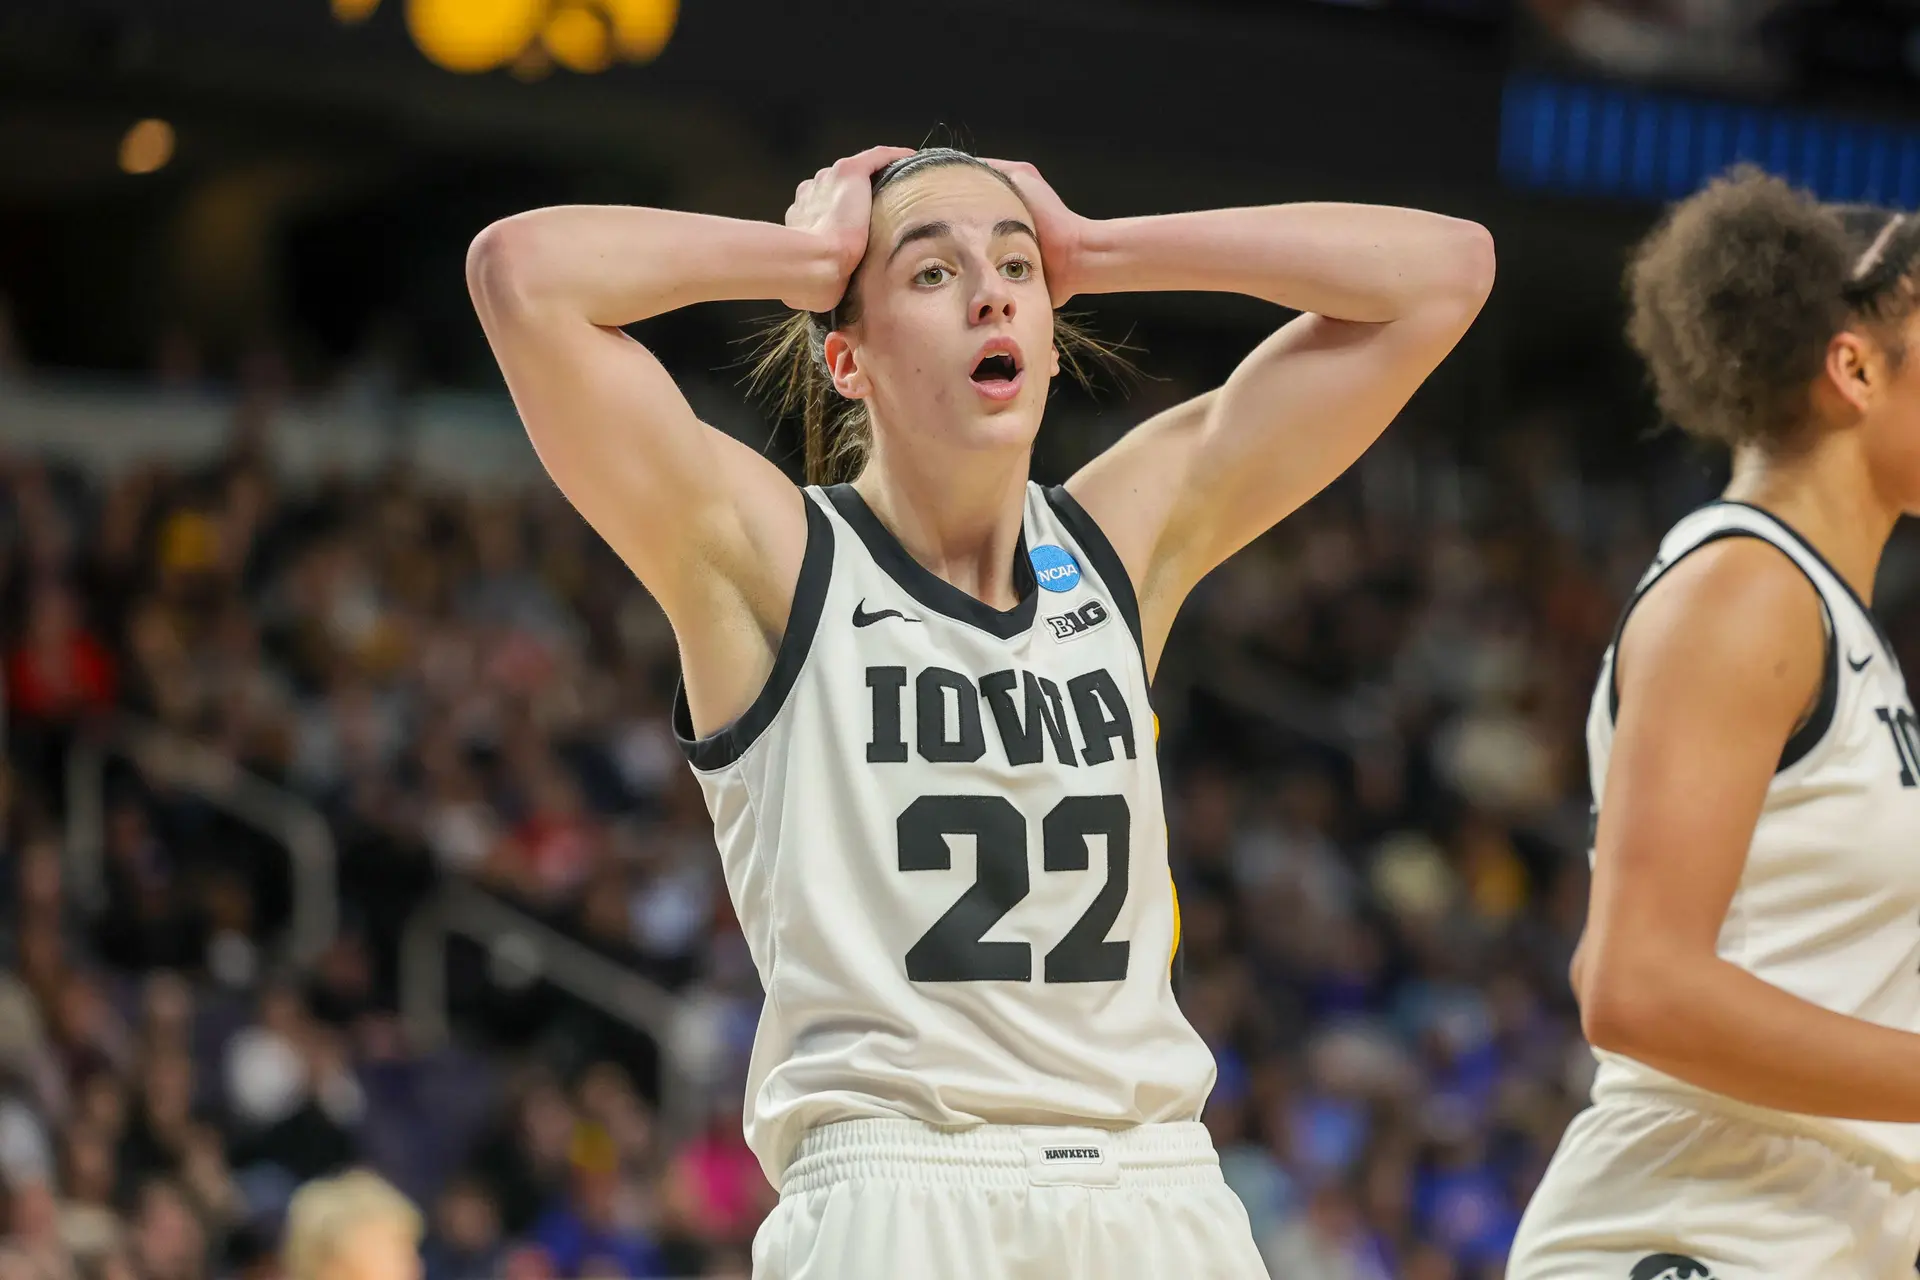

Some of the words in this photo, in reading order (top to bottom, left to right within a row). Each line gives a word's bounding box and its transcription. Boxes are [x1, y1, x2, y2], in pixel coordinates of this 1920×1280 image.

[1037, 564, 1078, 583] NCAA
[865, 666, 1137, 768] IOWA
[897, 794, 1131, 983] 22
[1044, 1149, 1100, 1160] HAWKEYES
